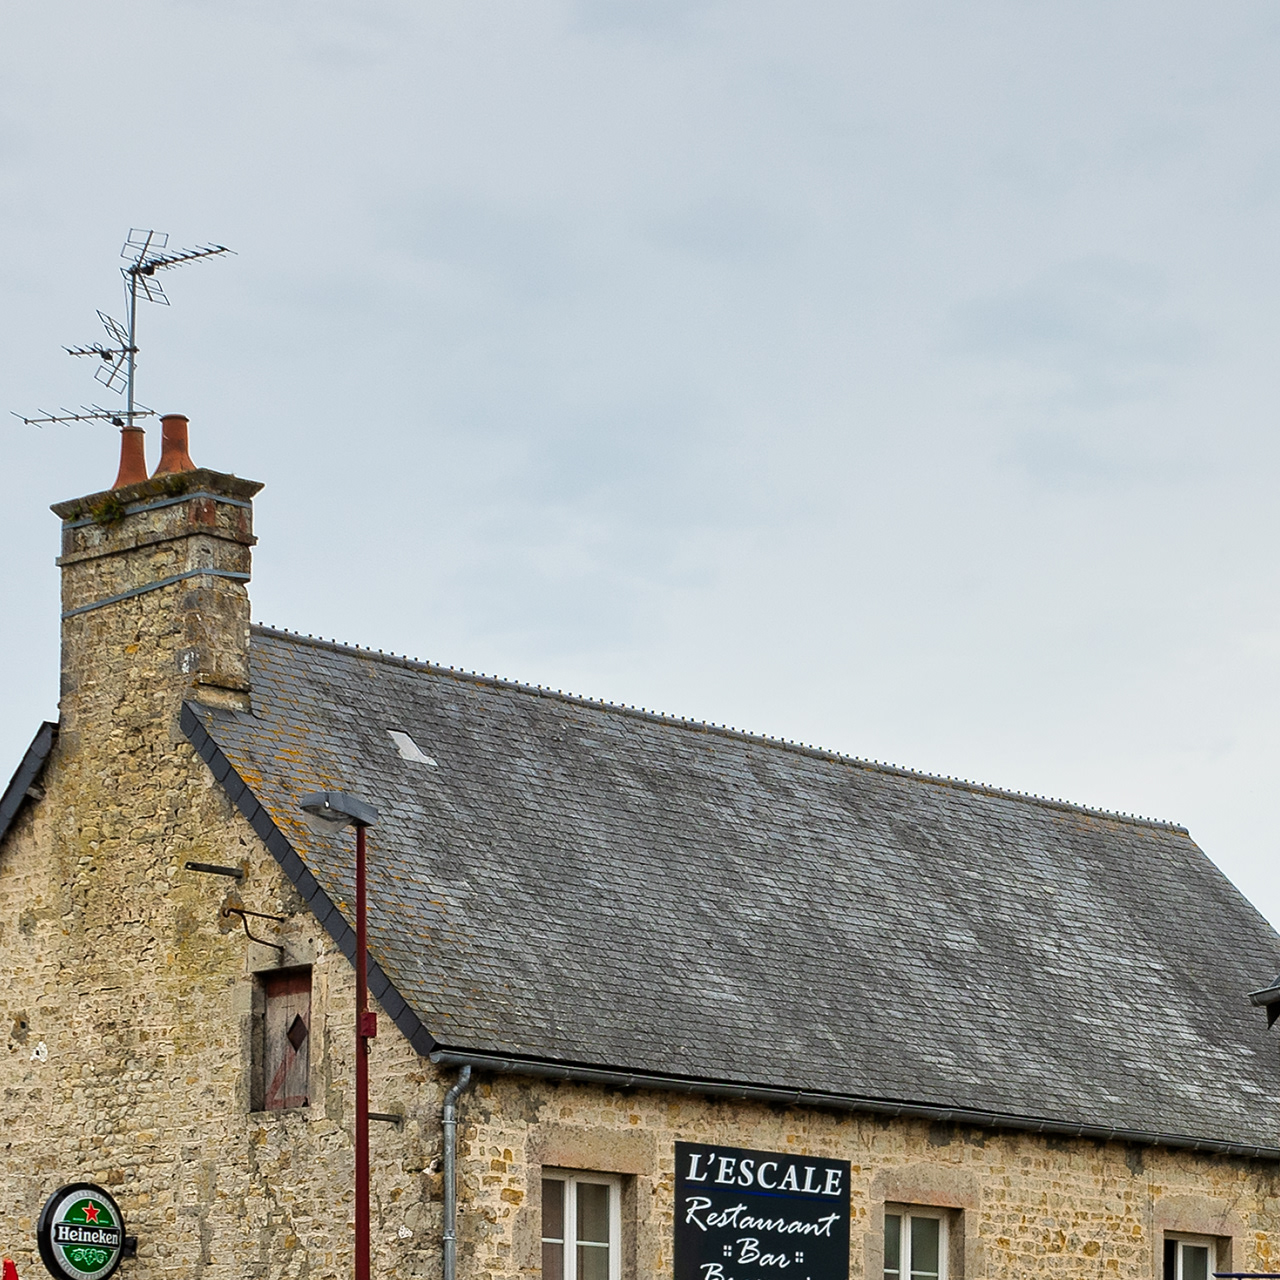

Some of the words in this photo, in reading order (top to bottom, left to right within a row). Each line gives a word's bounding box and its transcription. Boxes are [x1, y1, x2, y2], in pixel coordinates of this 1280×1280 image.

[685, 1153, 843, 1196] L'ESCALE
[684, 1197, 841, 1237] Restaurant
[57, 1226, 119, 1245] Heineken
[735, 1237, 791, 1269] Bar
